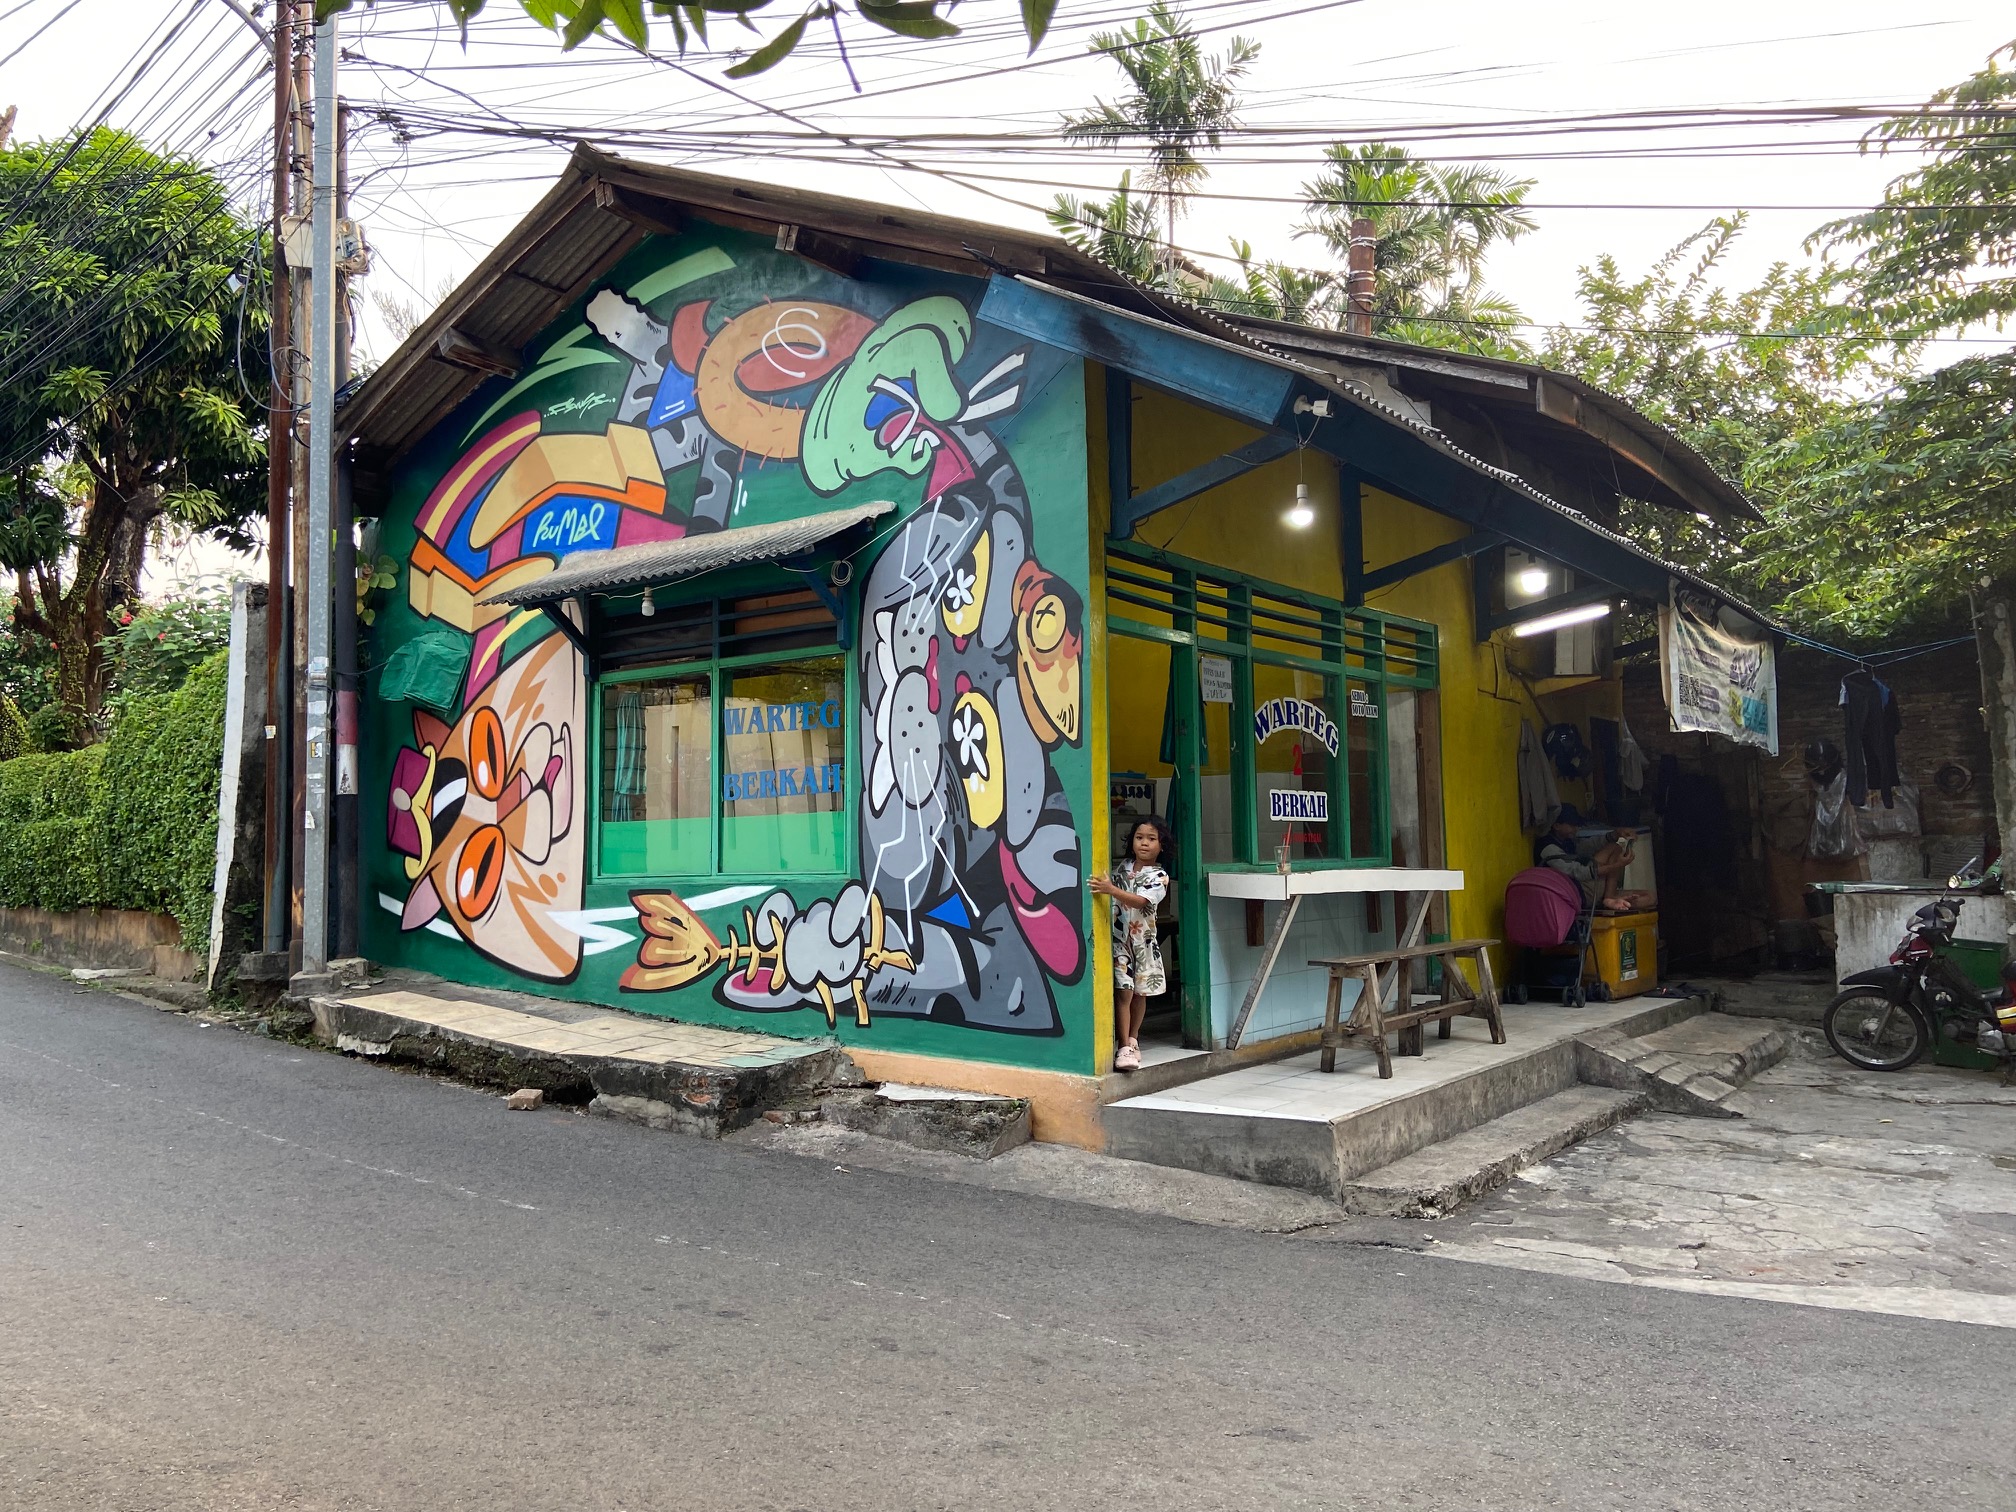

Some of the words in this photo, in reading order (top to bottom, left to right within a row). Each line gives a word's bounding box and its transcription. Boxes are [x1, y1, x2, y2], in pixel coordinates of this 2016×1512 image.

[723, 700, 841, 736] WARTEG
[1255, 700, 1338, 753] WARTEG
[1292, 744, 1303, 776] 2
[723, 764, 842, 801] BERKAH
[1271, 792, 1327, 819] BERKAH
